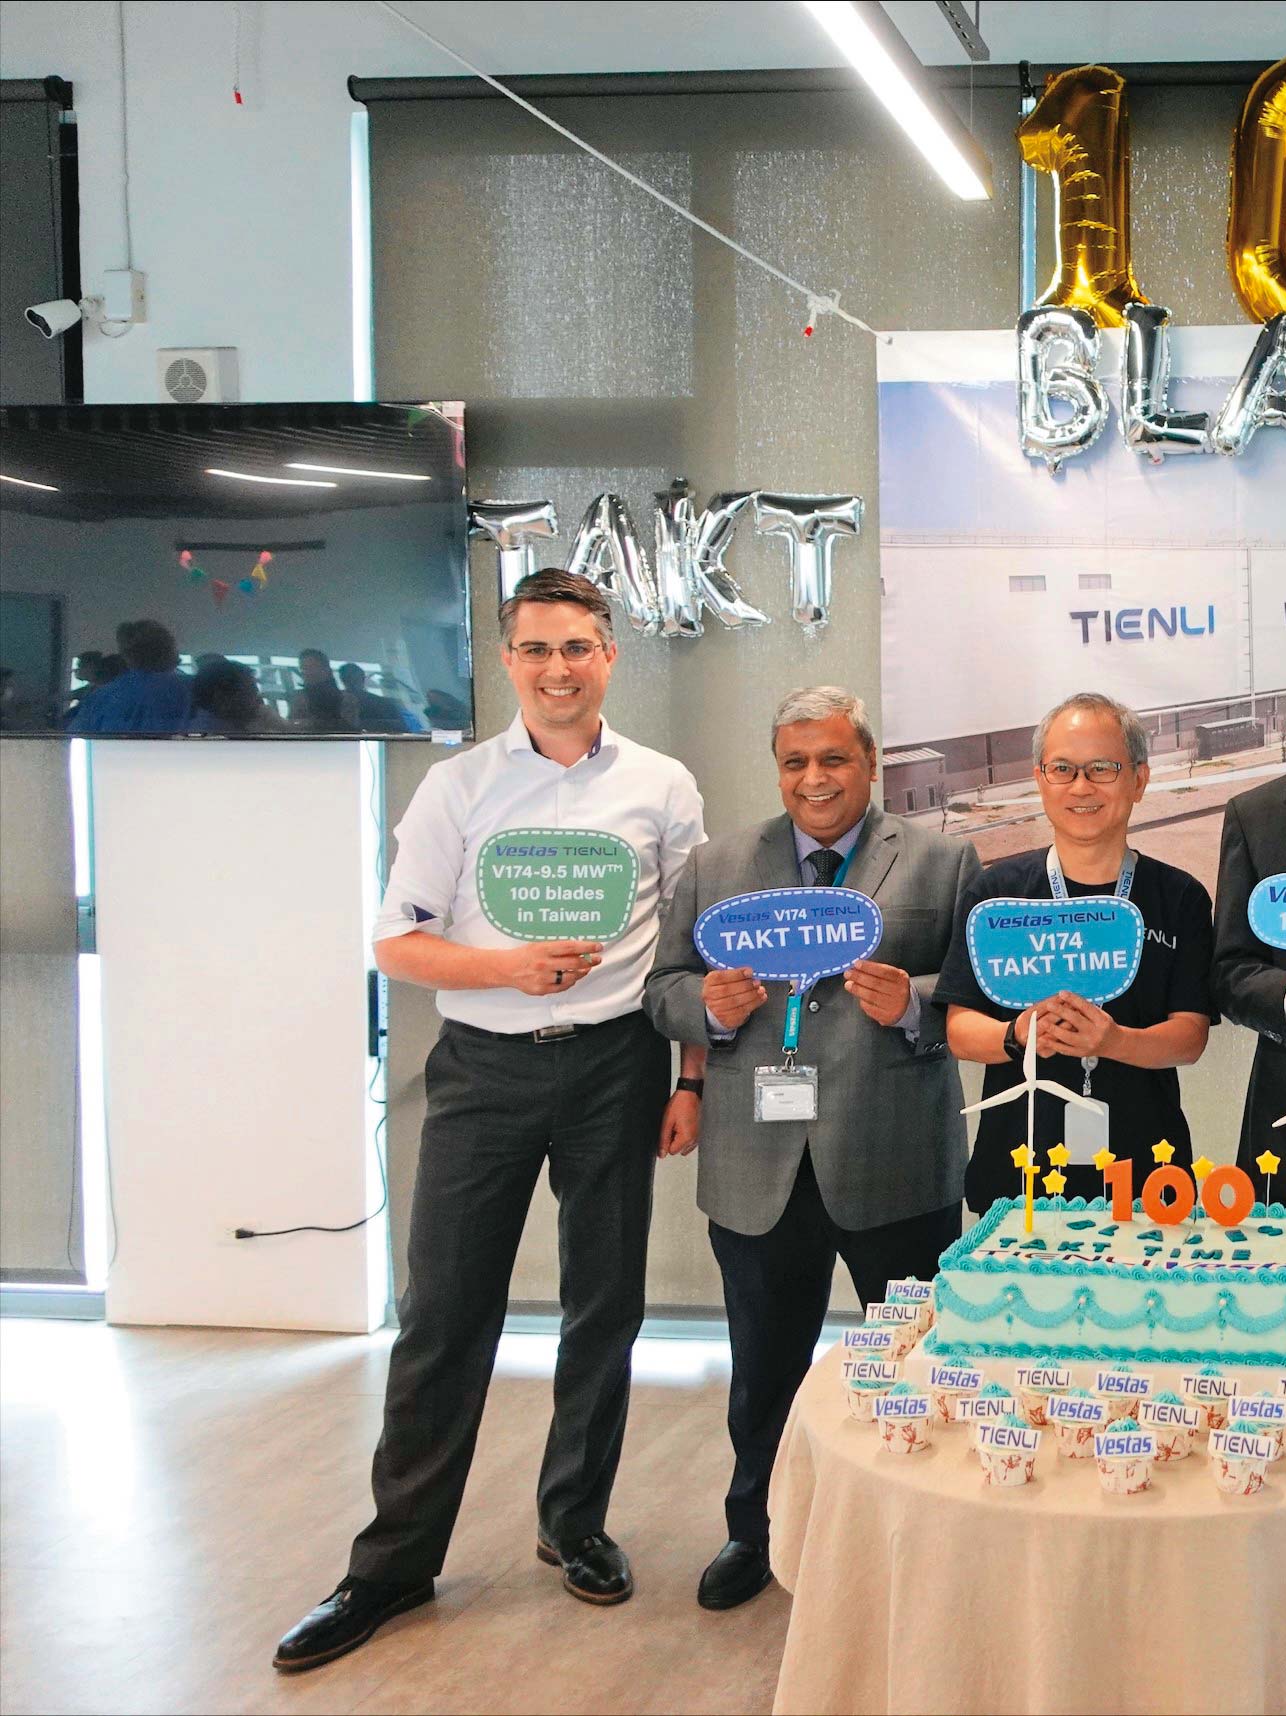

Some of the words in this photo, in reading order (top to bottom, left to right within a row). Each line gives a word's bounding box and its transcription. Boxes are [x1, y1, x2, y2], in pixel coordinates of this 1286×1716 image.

[468, 484, 865, 637] TAKT
[1070, 605, 1215, 643] TIENLI
[495, 845, 558, 857] Vestas
[563, 846, 617, 856] TIENLI
[492, 864, 568, 879] V174-9.5
[510, 887, 540, 901] 100
[545, 886, 605, 900] blades
[517, 908, 534, 922] in
[539, 907, 601, 922] Taiwan
[719, 909, 771, 925] Vestas
[774, 908, 808, 922] V174
[811, 904, 862, 918] TIENLI
[988, 914, 1053, 929] Vestas
[1058, 911, 1115, 924] TIENLI
[719, 927, 790, 951] TAKT
[798, 922, 867, 946] TIME
[1029, 932, 1084, 953] V174
[987, 955, 1055, 977] TAKT
[1063, 950, 1128, 972] TIME
[1104, 1158, 1256, 1227] 100
[999, 1236, 1112, 1253] TAKT
[1144, 1244, 1251, 1261] TIME
[887, 1282, 931, 1298] Vestas
[869, 1305, 917, 1320] TIENLI
[844, 1330, 892, 1347] Vestas
[843, 1362, 896, 1379] TIENLI
[930, 1367, 980, 1388] Vestas
[1017, 1369, 1070, 1386] TIENLI
[1097, 1373, 1149, 1394] Vestas
[1183, 1377, 1237, 1397] TIENLI
[874, 1397, 928, 1416] Vestas
[960, 1400, 1016, 1416] TIENLI
[1050, 1398, 1103, 1420] Vestas
[1142, 1403, 1199, 1426] TIENLI
[1231, 1398, 1284, 1419] Vestas
[980, 1425, 1038, 1449] TIENLI
[1095, 1435, 1152, 1456] Vestas
[1213, 1433, 1271, 1457] TIENLI
